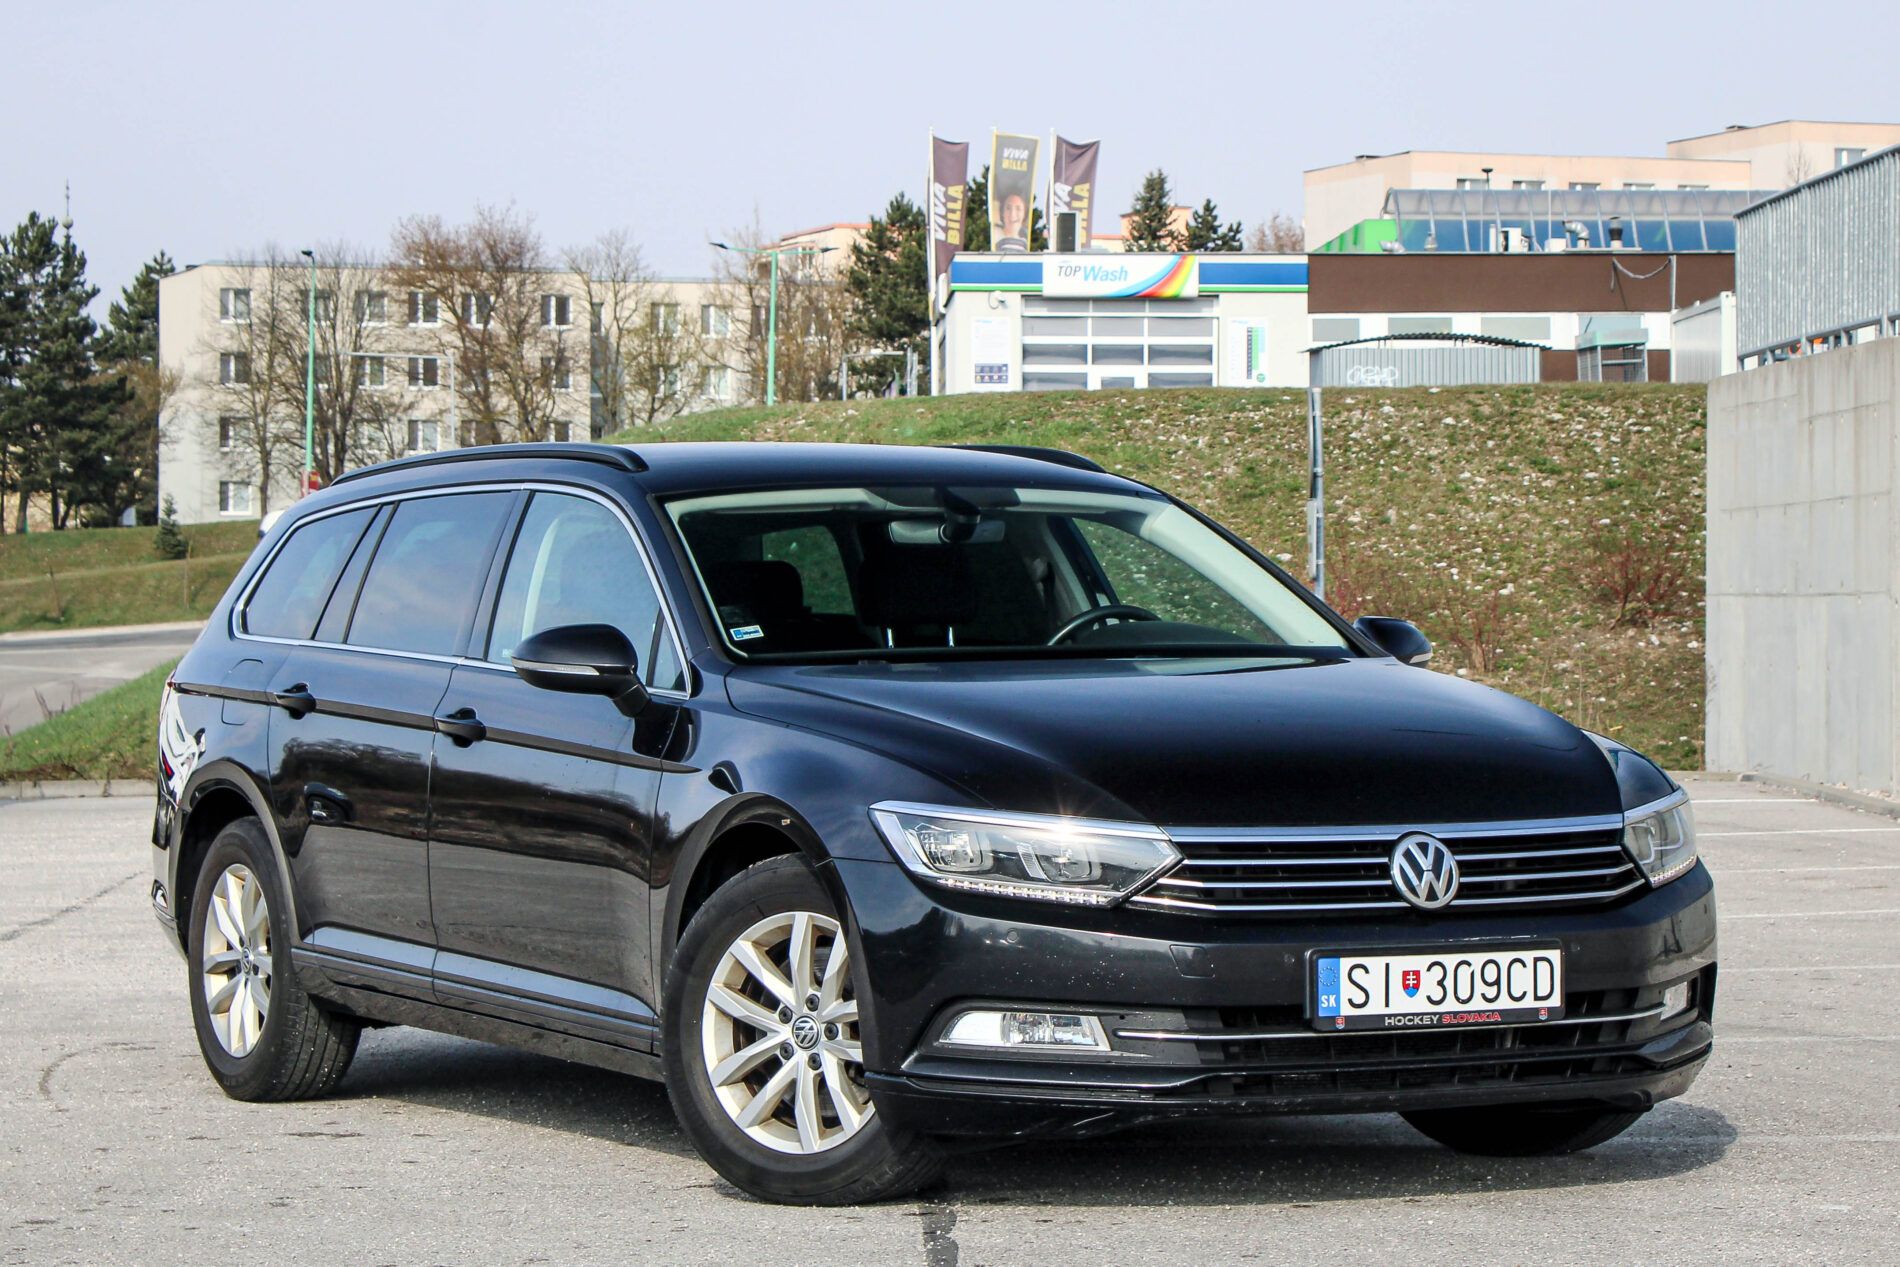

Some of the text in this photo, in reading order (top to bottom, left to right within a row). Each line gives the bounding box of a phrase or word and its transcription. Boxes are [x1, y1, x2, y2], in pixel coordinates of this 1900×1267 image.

[1003, 147, 1029, 159] VIVA
[946, 184, 964, 245] BILLA
[1057, 264, 1128, 281] TOP Wash
[1347, 956, 1555, 1009] SI 309CD
[1321, 994, 1337, 1008] SK
[1384, 1012, 1501, 1026] HOCKEY SLOVAKIA
